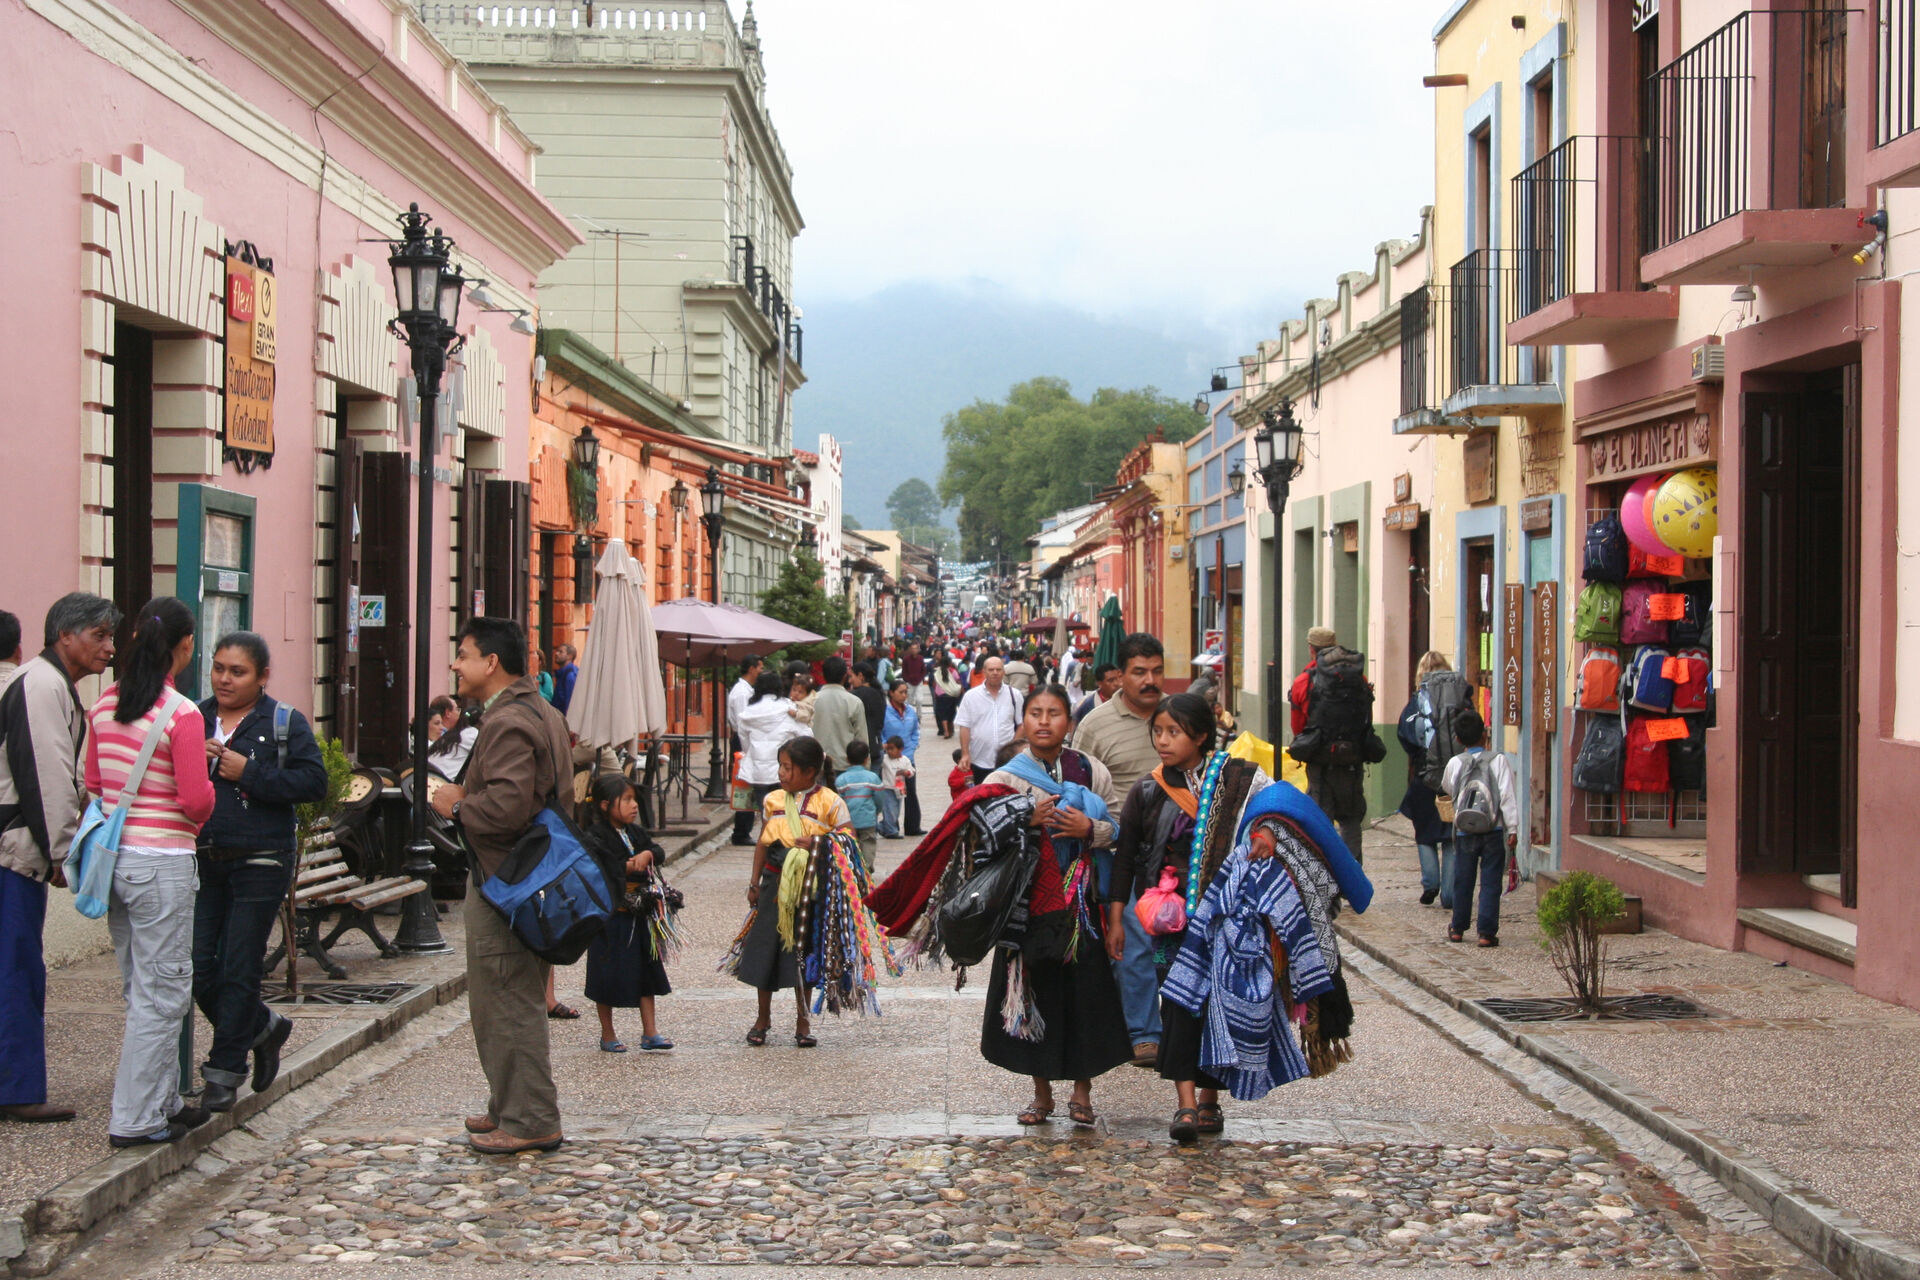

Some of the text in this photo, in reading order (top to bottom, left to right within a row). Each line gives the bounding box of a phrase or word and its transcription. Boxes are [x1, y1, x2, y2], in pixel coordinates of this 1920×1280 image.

[233, 280, 253, 313] flexi
[256, 340, 276, 360] EMYCO
[258, 322, 275, 342] GRAN
[232, 403, 269, 445] Catedral
[1611, 434, 1627, 473] EL
[1630, 422, 1688, 470] PLANETA
[1505, 585, 1520, 724] Travel Agency
[1540, 583, 1552, 730] Agenzia Viaggi
